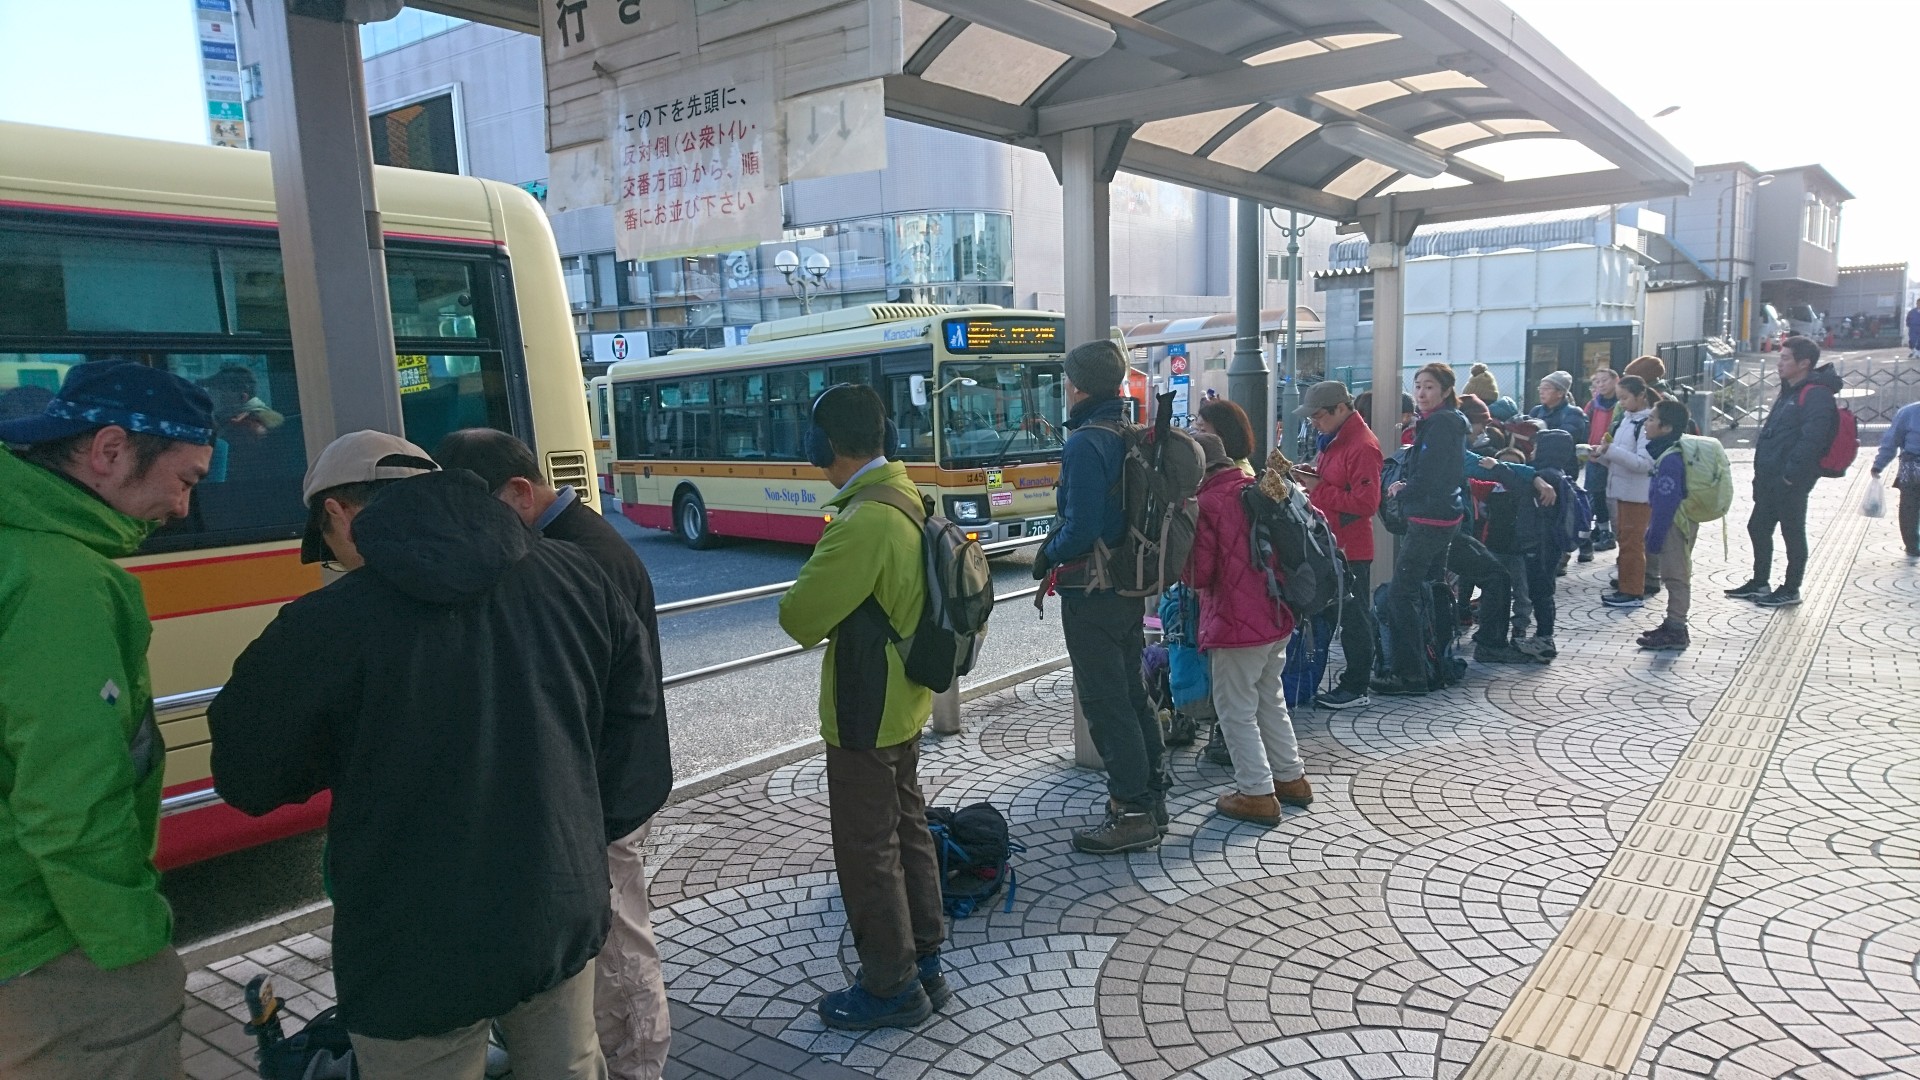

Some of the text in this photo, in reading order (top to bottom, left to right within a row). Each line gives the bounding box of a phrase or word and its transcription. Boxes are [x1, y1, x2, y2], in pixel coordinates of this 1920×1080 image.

[625, 87, 747, 132] この下を先頭に、
[624, 191, 755, 231] 番にお並び下さい
[883, 326, 921, 341] Kanachu
[1019, 476, 1053, 487] Kanachu
[764, 487, 816, 505] Non-Step Bus
